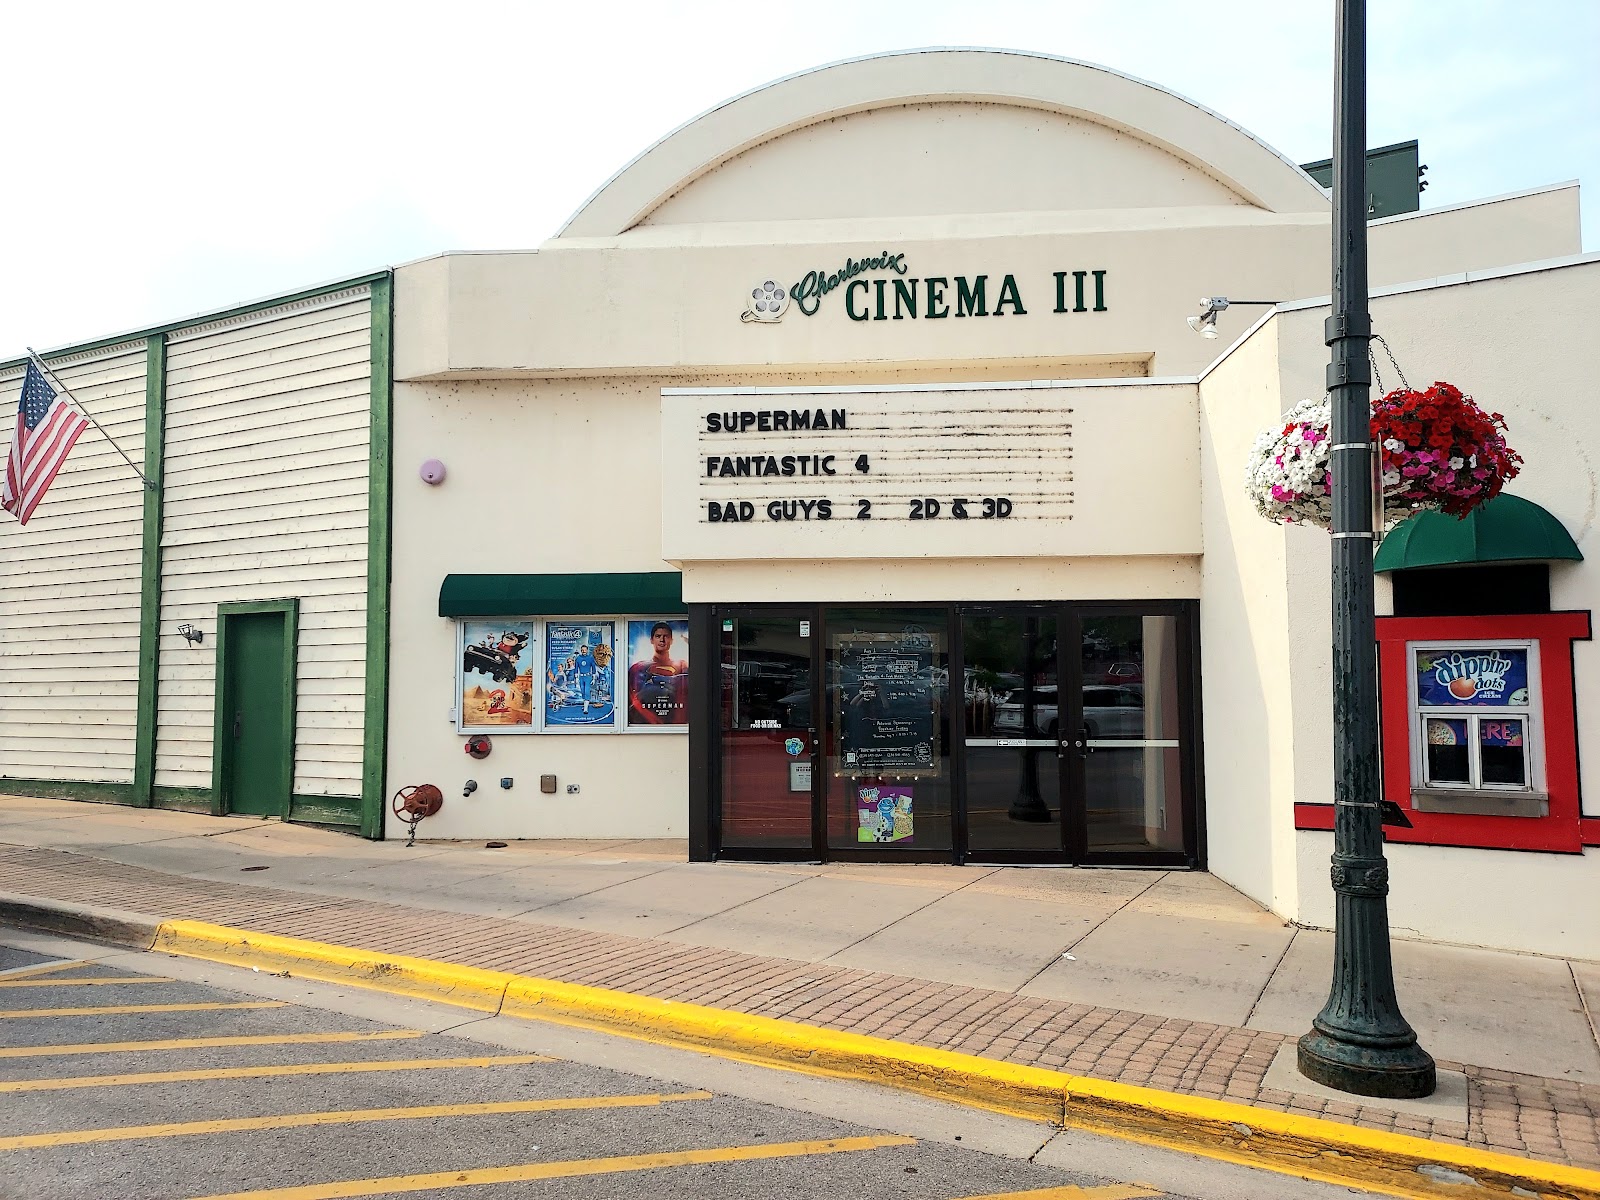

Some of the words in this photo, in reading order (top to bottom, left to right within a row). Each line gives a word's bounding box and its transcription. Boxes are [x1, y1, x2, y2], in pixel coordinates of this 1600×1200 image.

[790, 250, 908, 316] Charlevoix
[845, 274, 1028, 321] CINEMA
[1053, 269, 1108, 314] III
[706, 408, 847, 432] SUPERMAN
[706, 455, 837, 477] FANTASTIC
[854, 454, 870, 474] 4
[707, 501, 755, 522] BAD
[767, 499, 833, 521] GUYS
[856, 499, 872, 519] 2
[909, 498, 941, 519] 2D
[951, 498, 969, 518] &
[982, 497, 1013, 518] 3D
[1475, 676, 1506, 691] dots
